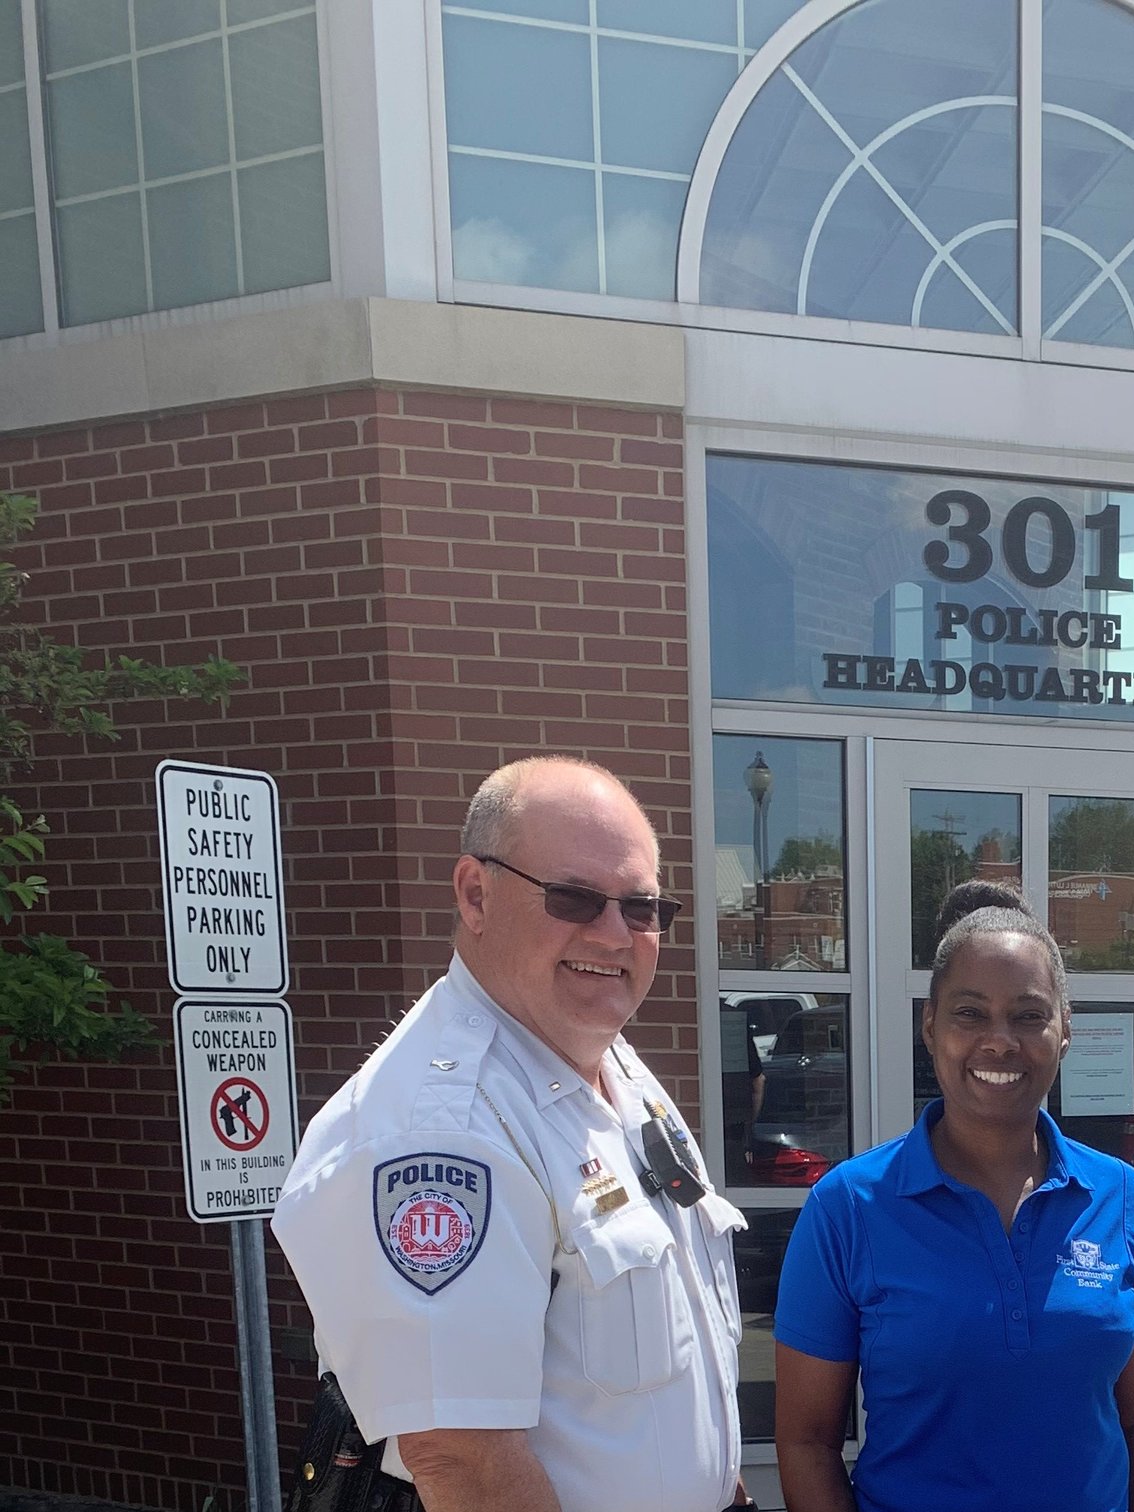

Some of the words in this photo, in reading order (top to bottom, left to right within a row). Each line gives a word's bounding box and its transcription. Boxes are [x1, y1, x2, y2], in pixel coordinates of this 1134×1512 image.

[923, 489, 1134, 593] 301
[935, 602, 1122, 650] POLICE
[186, 788, 251, 822] PUBLIC
[188, 828, 253, 860] SAFETY
[173, 866, 273, 899] PERSONNEL
[187, 906, 265, 936] PARKING
[206, 945, 251, 973] ONLY
[204, 1010, 251, 1024] CARRNG
[256, 1011, 262, 1023] A
[192, 1030, 277, 1049] CONCEALED
[207, 1053, 266, 1072] WEAPON
[201, 1158, 211, 1171] IN
[216, 1158, 237, 1170] THIS
[242, 1155, 285, 1169] BUILDING
[239, 1172, 248, 1184] IS
[388, 1163, 478, 1194] POLICE
[409, 1194, 423, 1205] THE
[424, 1192, 441, 1200] CITY
[442, 1196, 453, 1204] OF
[1063, 1267, 1113, 1281] Community
[1100, 1261, 1120, 1271] State
[1077, 1278, 1103, 1288] Bank
